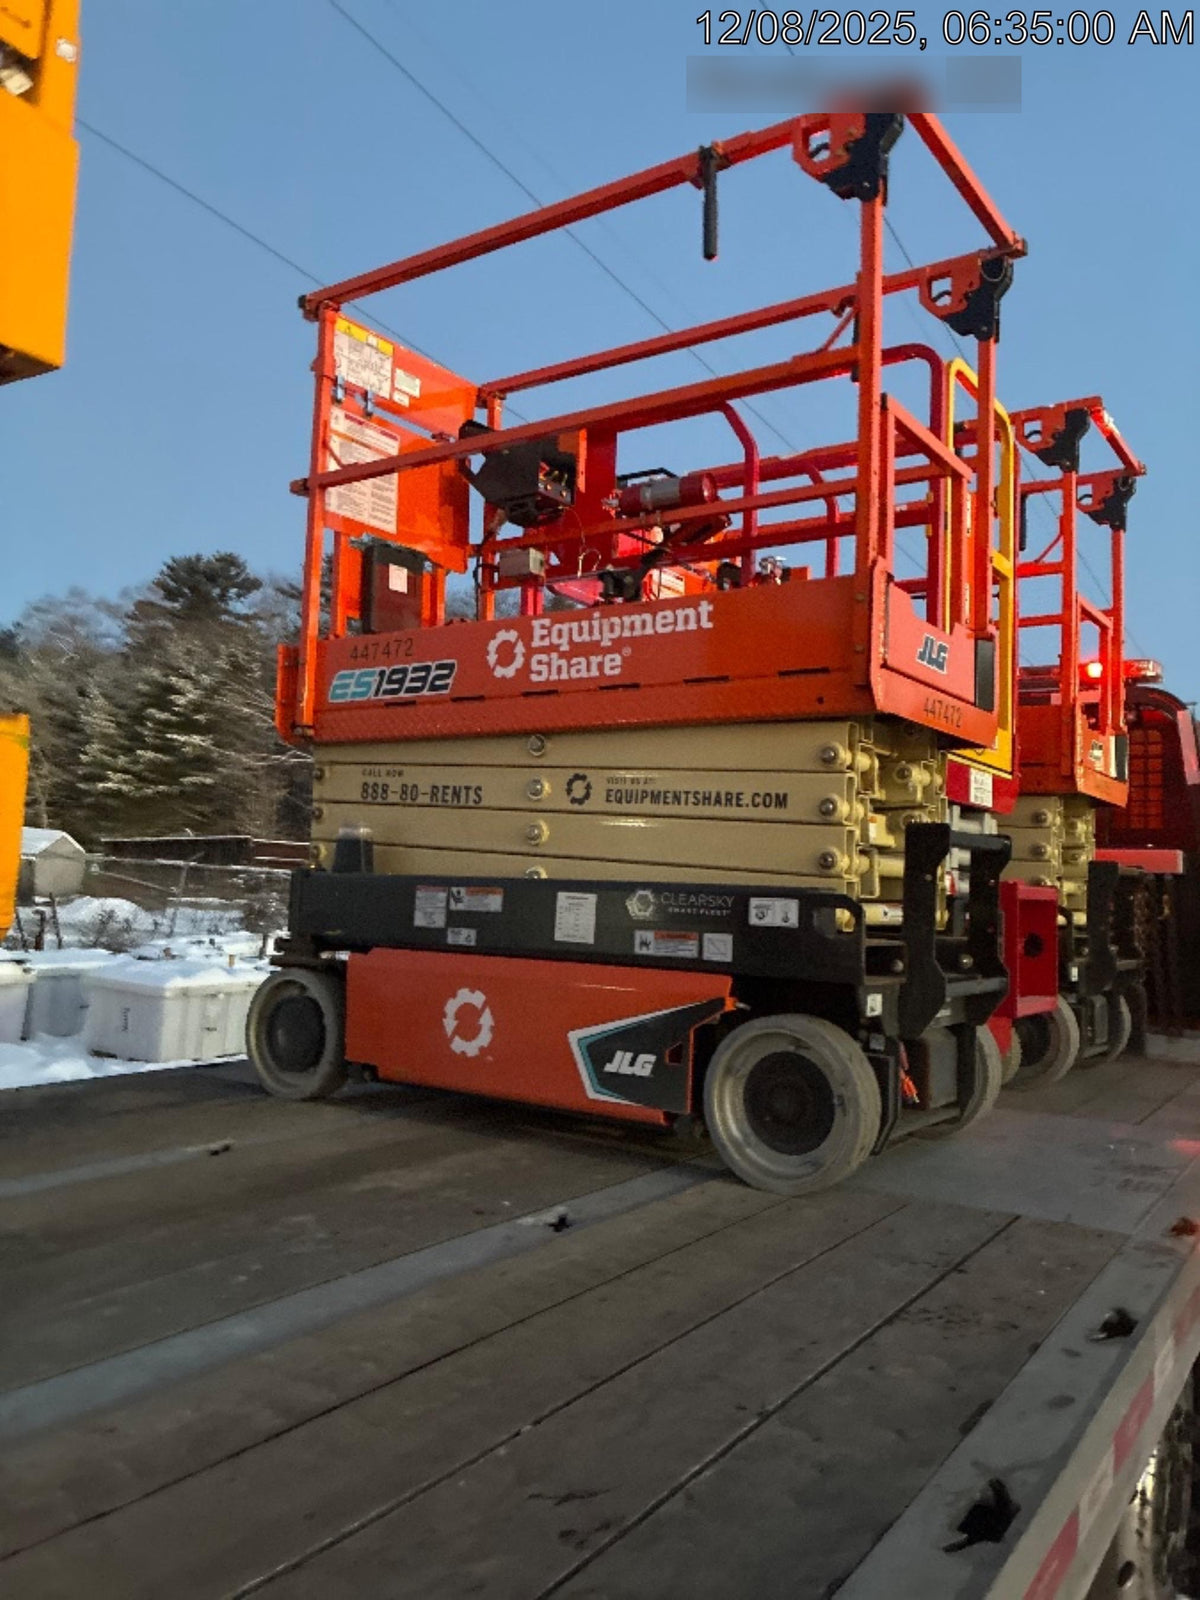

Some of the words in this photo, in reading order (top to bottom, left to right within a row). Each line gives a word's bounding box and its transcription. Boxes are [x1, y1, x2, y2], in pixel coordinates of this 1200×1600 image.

[531, 600, 714, 652] Equipment
[350, 638, 413, 660] 447472
[917, 634, 949, 674] JLG
[329, 660, 457, 702] ES1932
[361, 782, 483, 804] 888-80-RENTS
[605, 788, 788, 809] EQUIPMENTSHARE.COM
[661, 892, 735, 907] CLEARSKY
[603, 1050, 657, 1077] JLG
